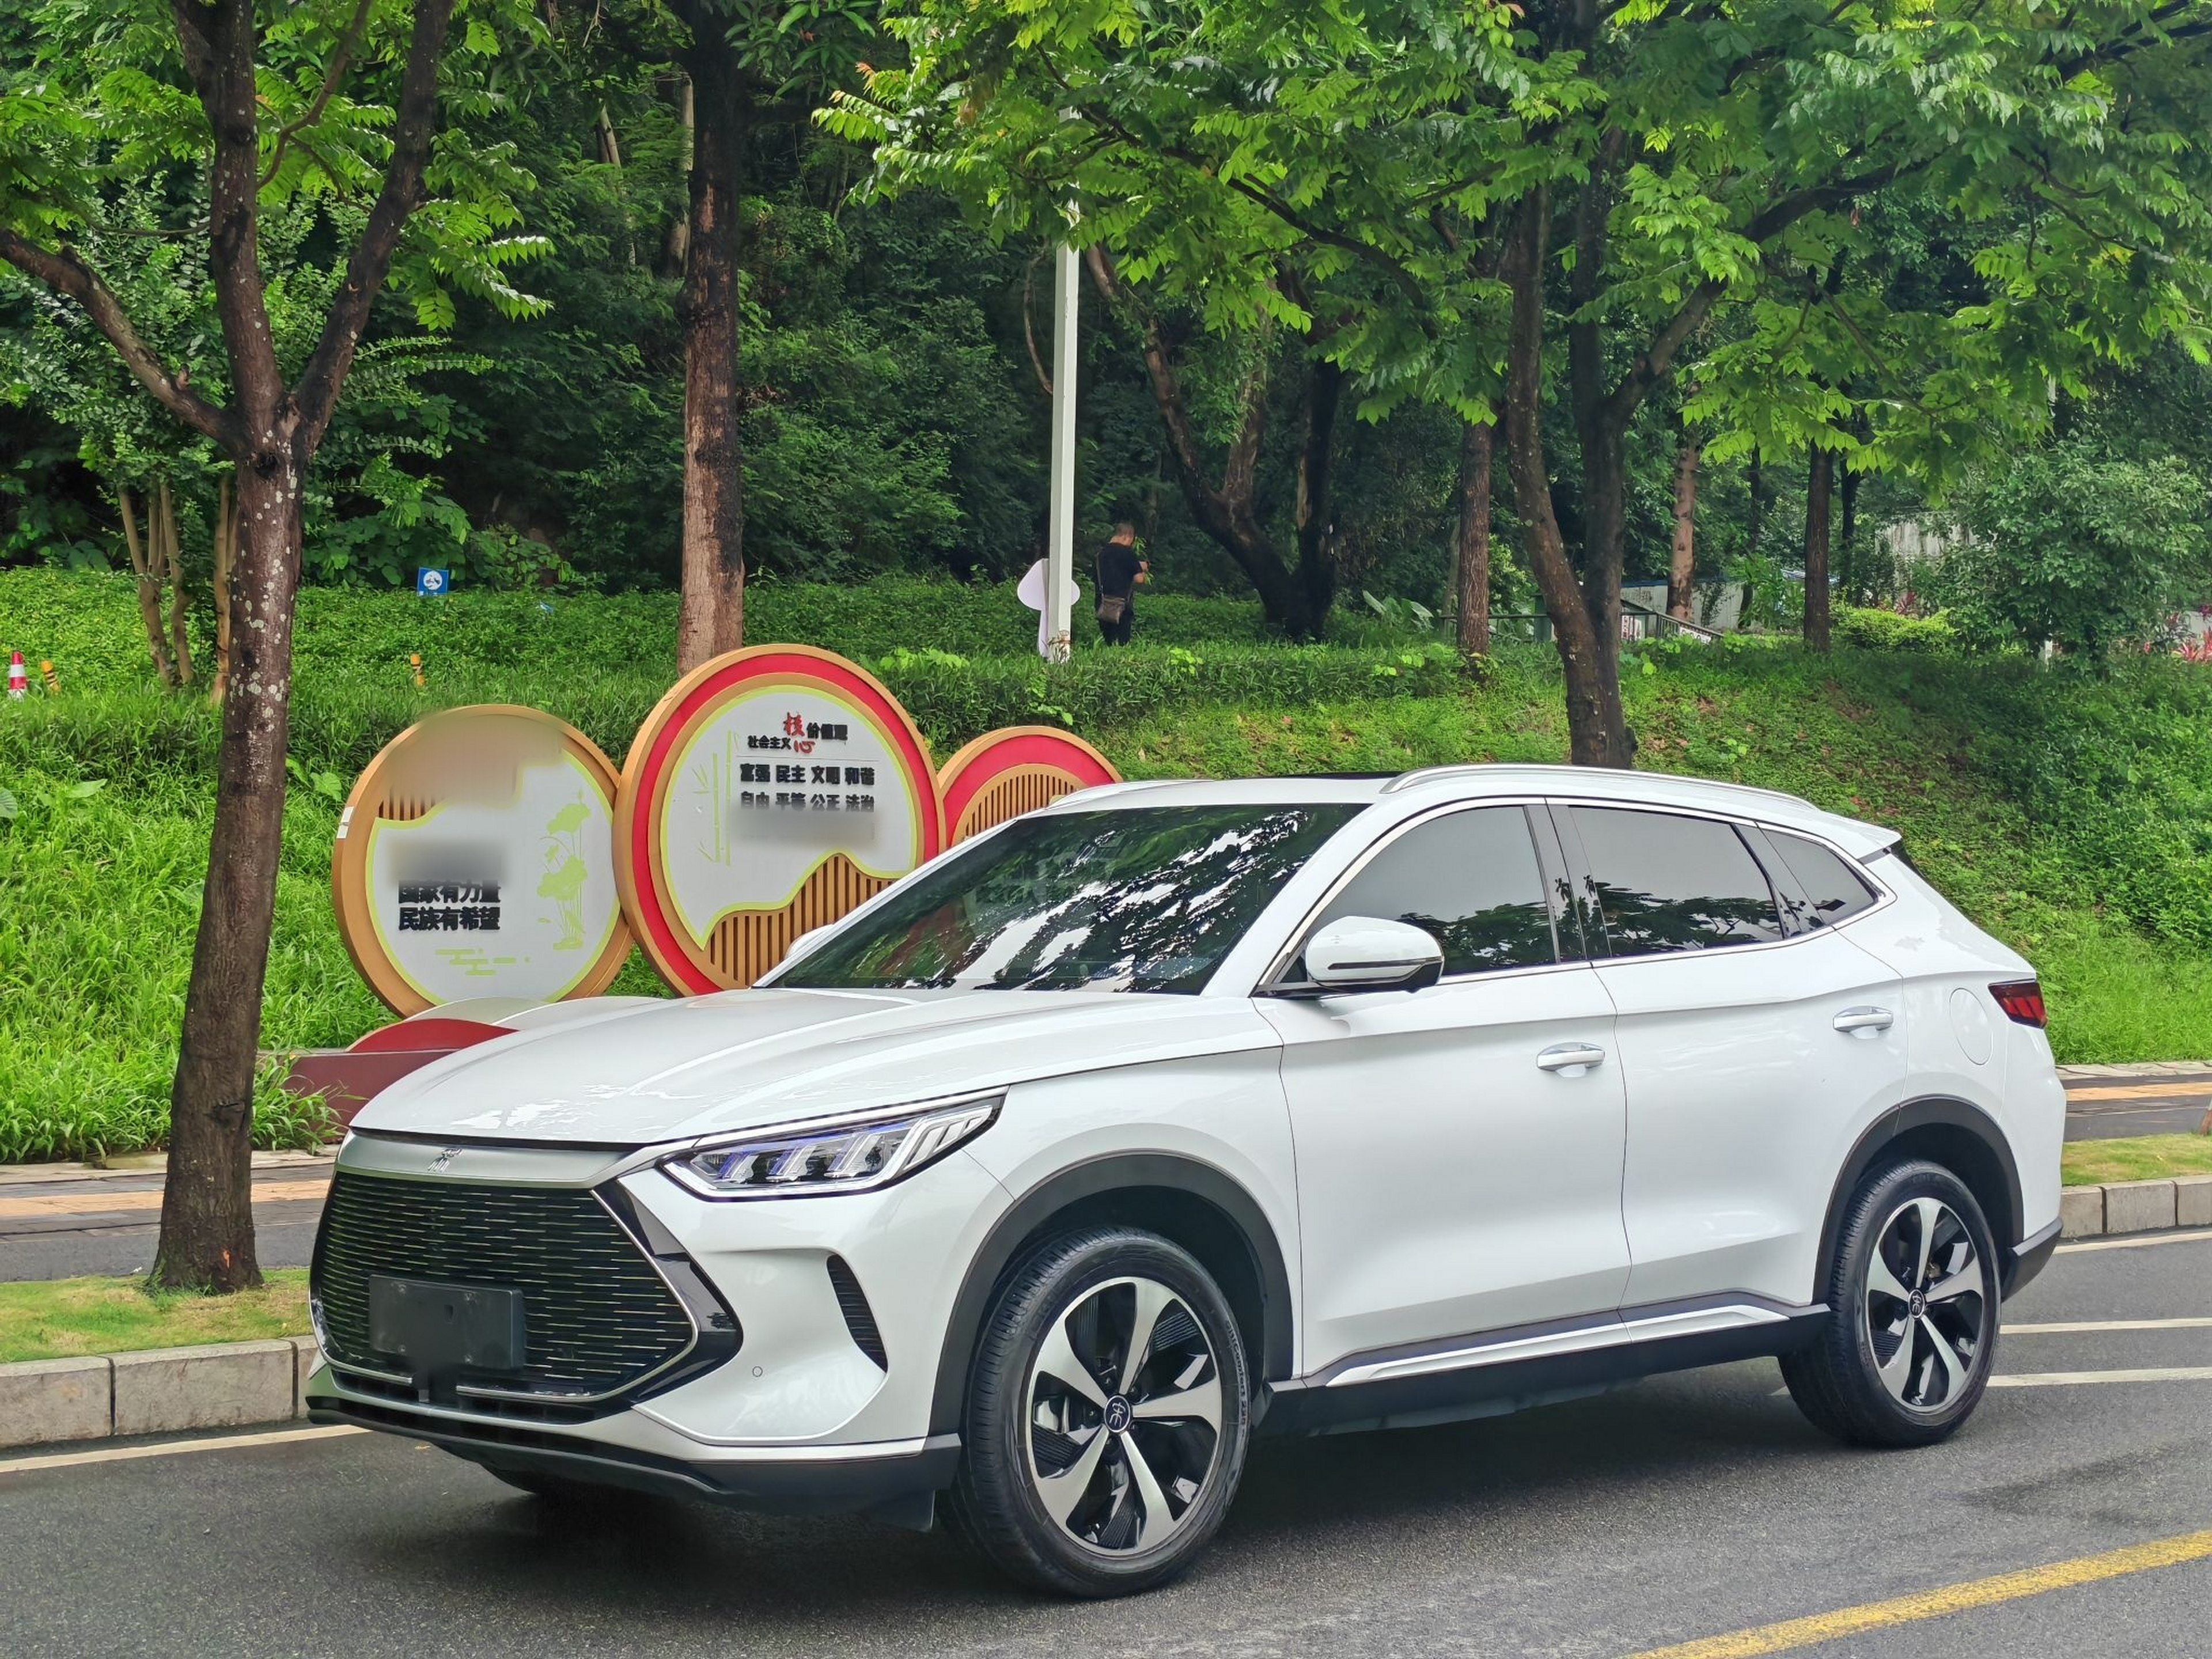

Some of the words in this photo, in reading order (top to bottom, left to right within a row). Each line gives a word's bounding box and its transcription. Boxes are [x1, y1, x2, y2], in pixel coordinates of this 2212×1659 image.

[748, 735, 791, 749] 社会主义
[776, 764, 806, 783] 民主
[845, 767, 874, 785] 和谐
[810, 794, 840, 812] 公正
[399, 906, 501, 931] 民族有希望
